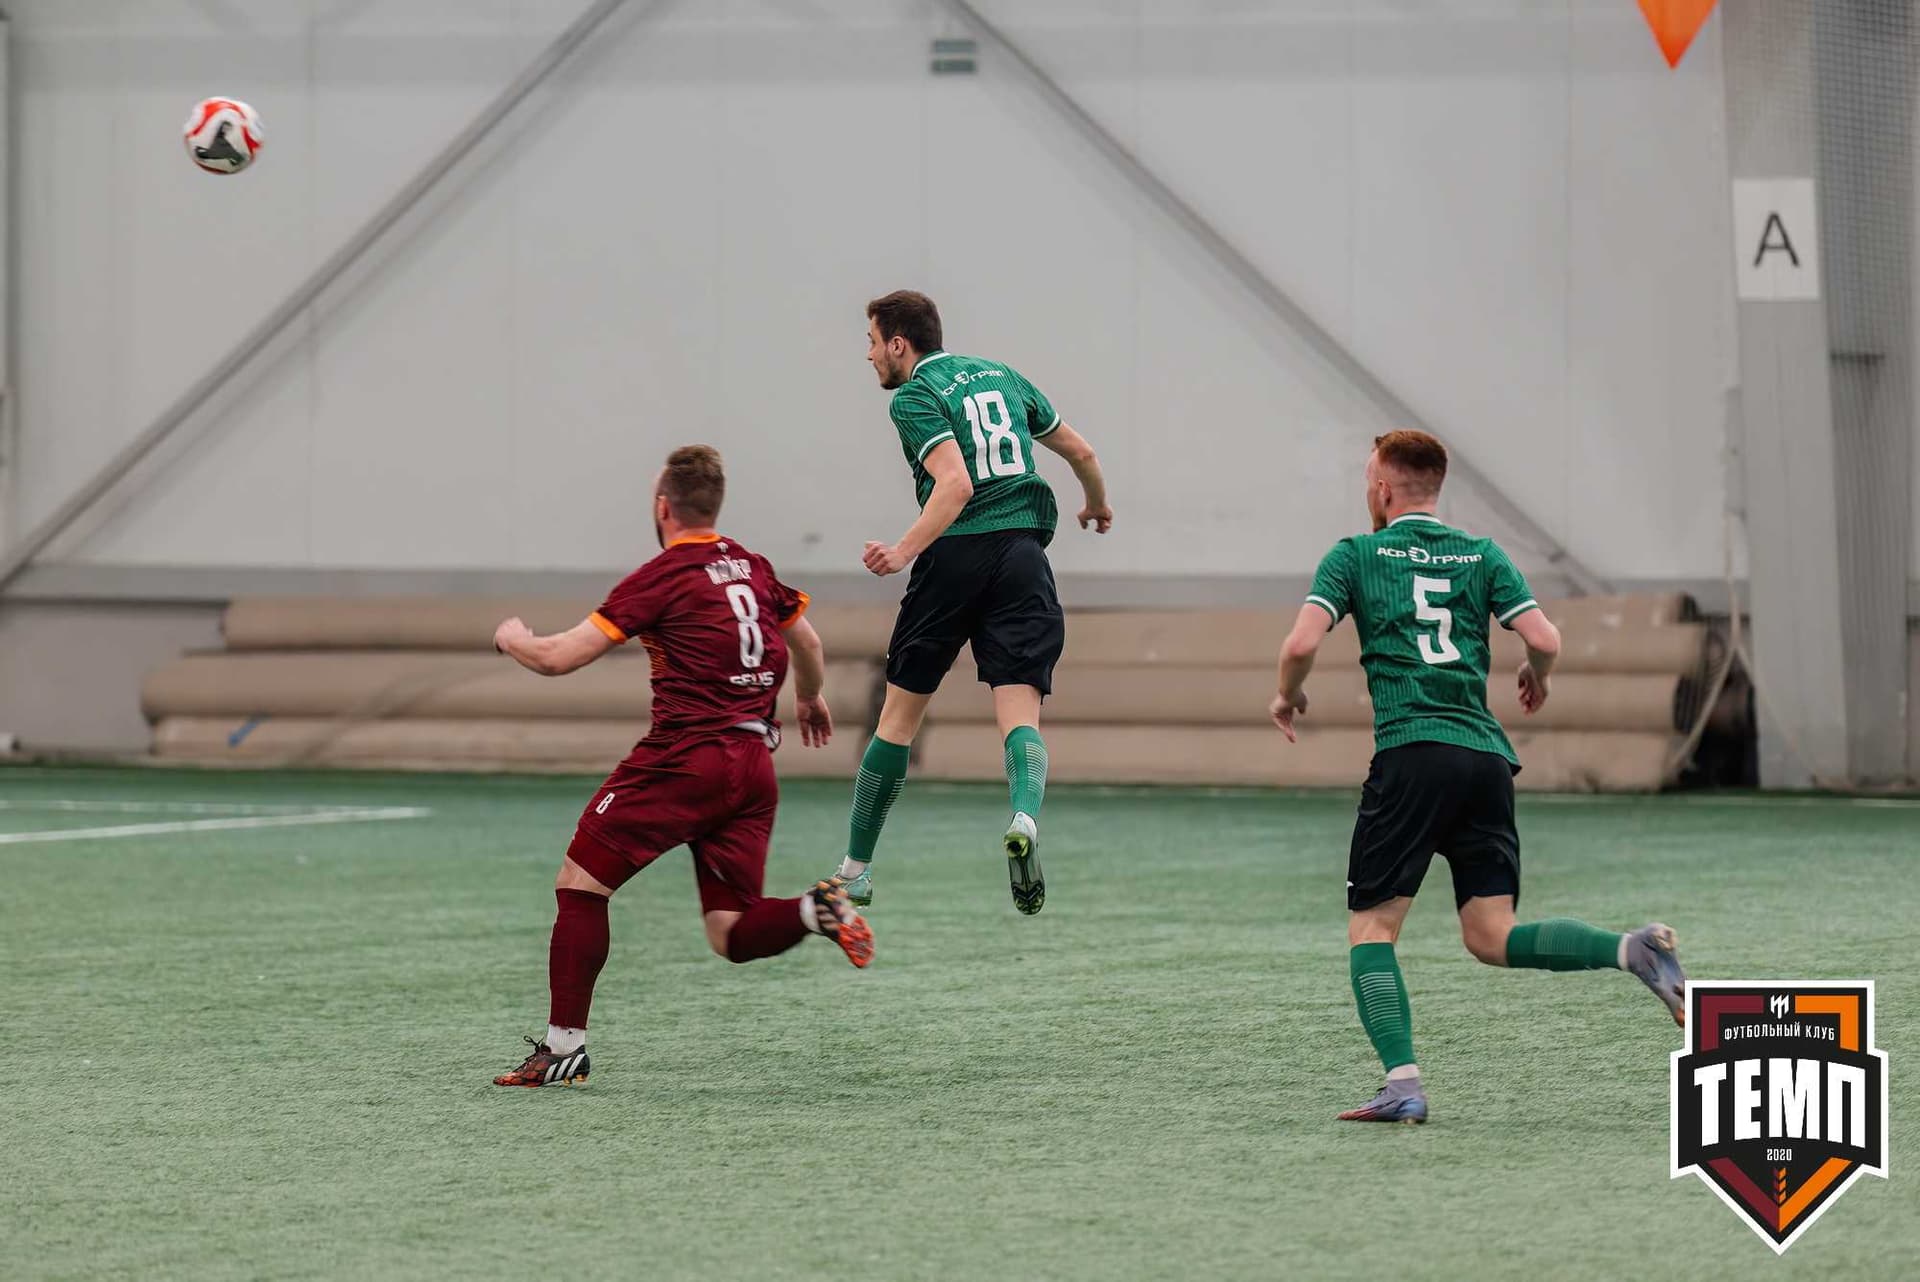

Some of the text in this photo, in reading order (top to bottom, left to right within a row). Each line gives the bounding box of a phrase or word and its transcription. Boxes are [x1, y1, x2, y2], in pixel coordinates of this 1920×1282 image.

[1753, 212, 1799, 268] А
[962, 390, 1026, 481] 18
[1377, 547, 1482, 564] АСР ГРУПП
[725, 584, 764, 669] 8
[1413, 574, 1461, 664] 5
[595, 792, 616, 815] 8
